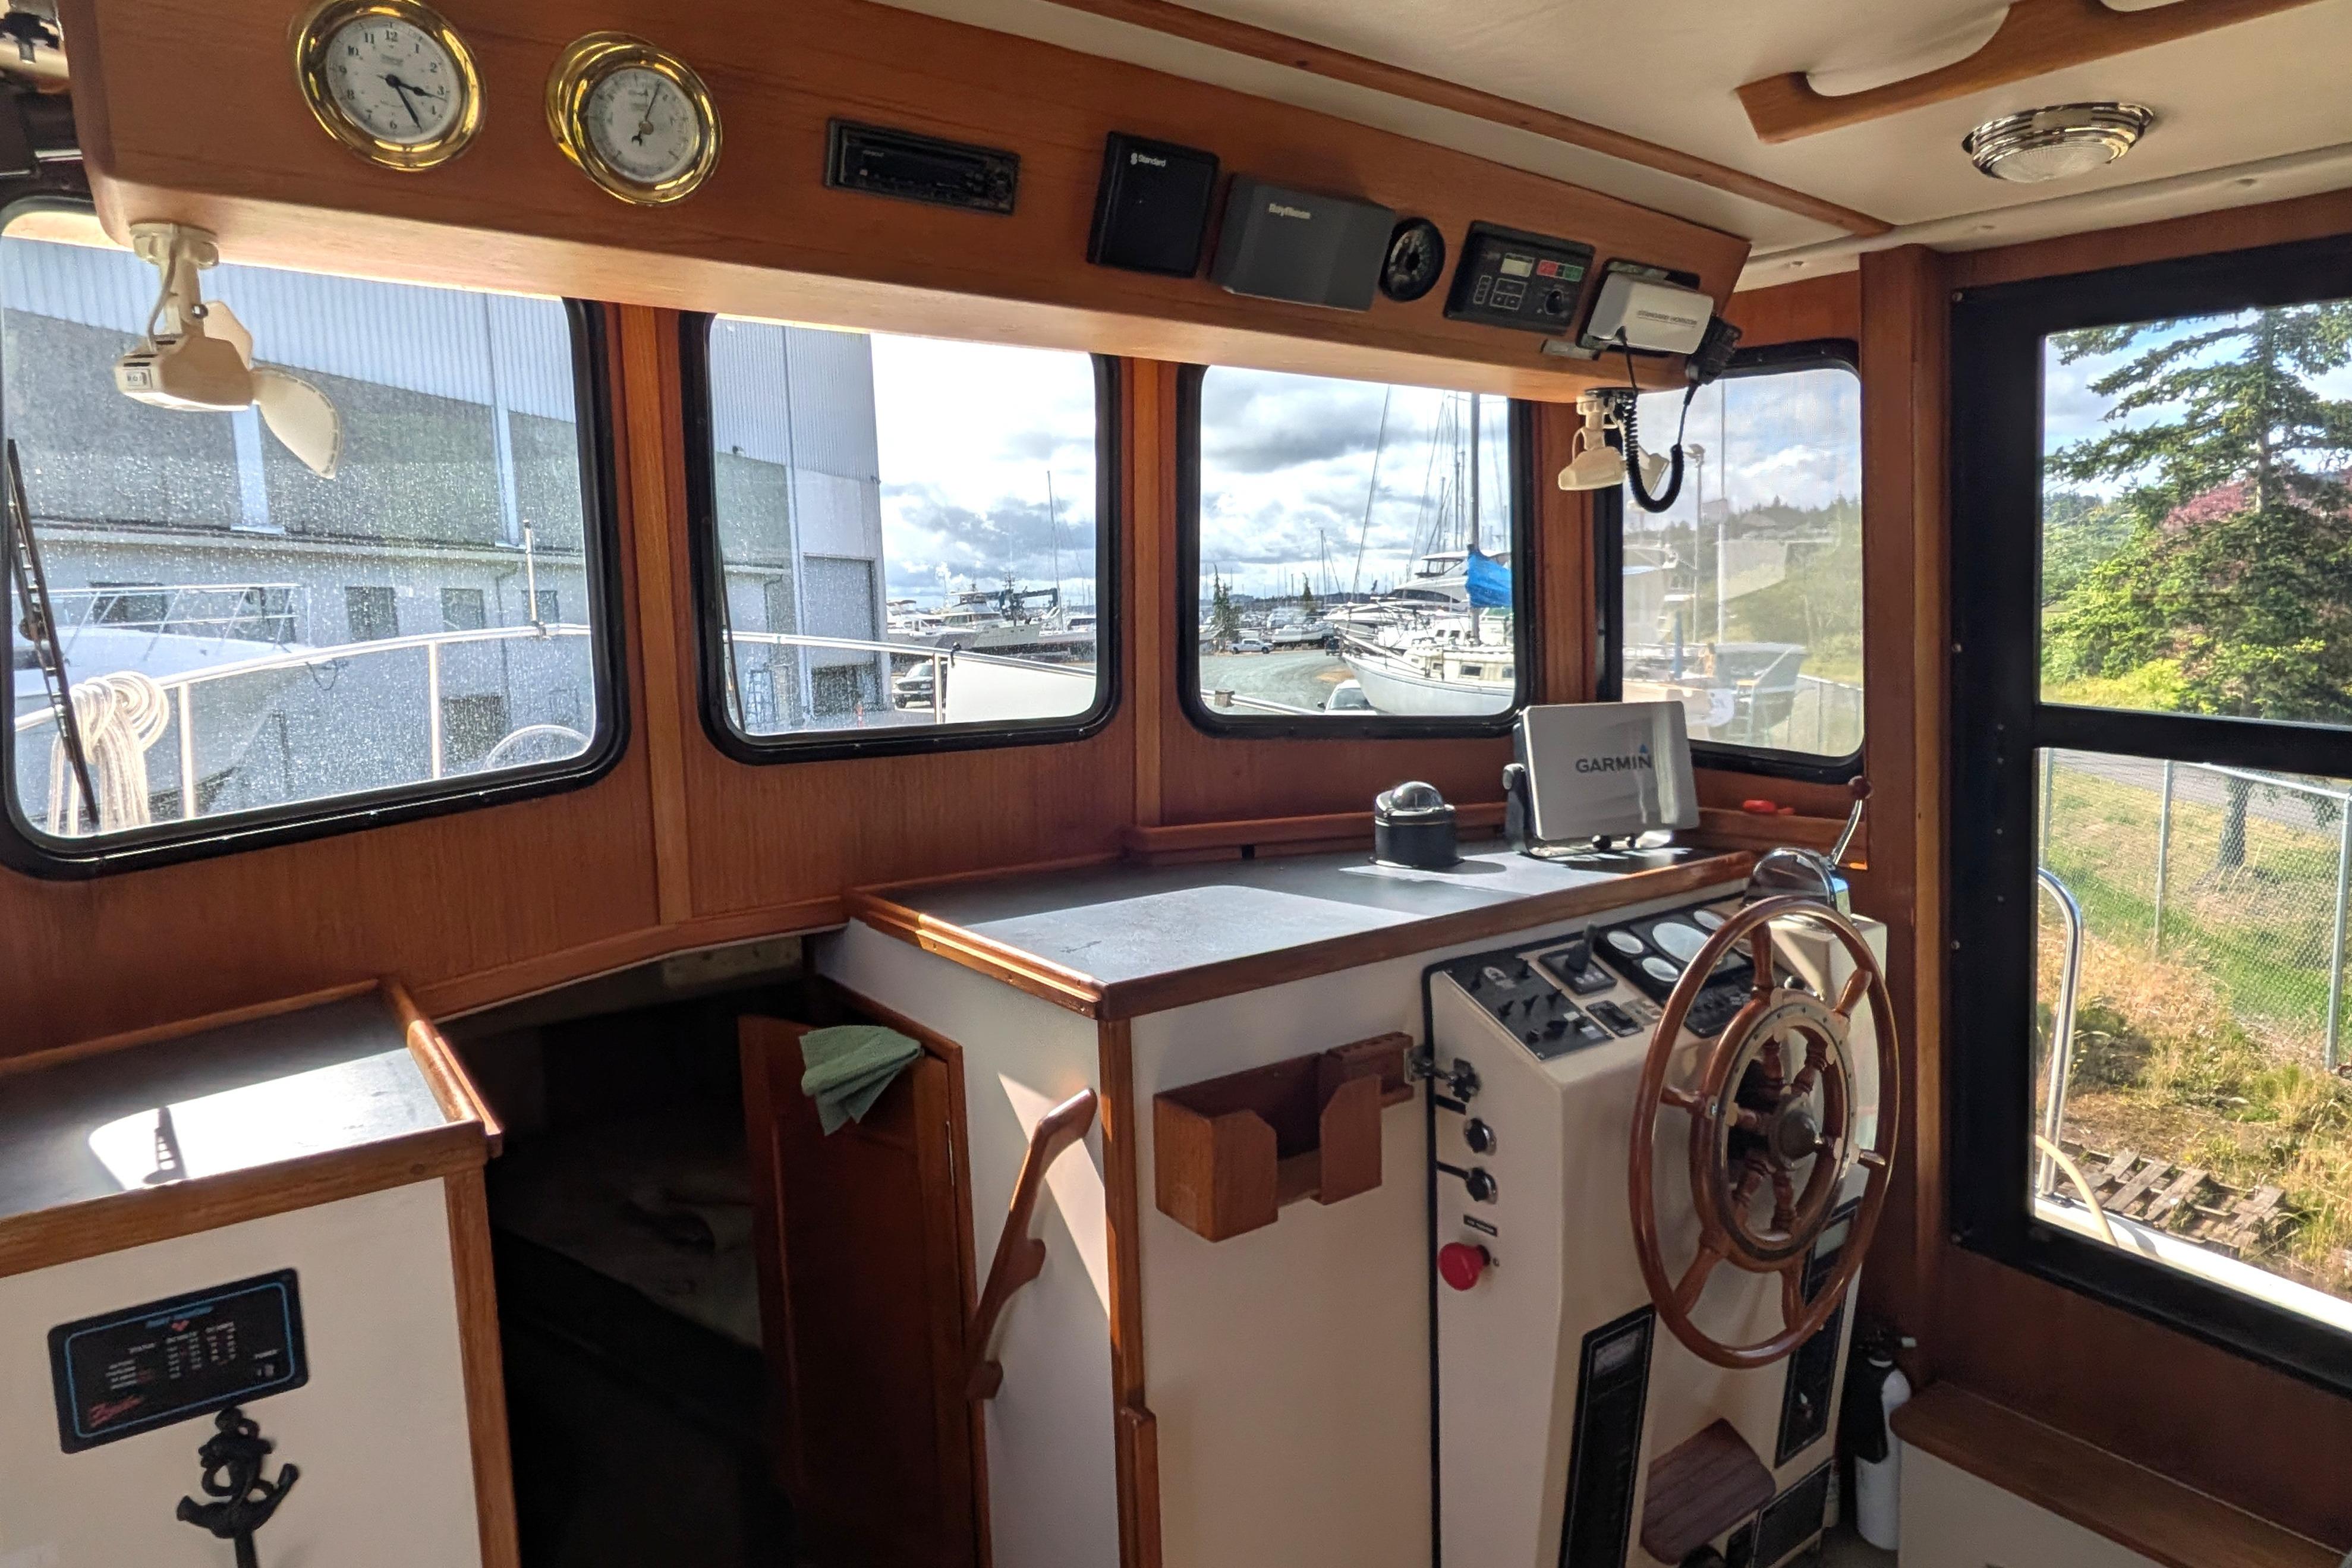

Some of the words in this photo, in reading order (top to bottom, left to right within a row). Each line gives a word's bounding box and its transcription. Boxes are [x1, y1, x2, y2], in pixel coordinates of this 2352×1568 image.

[364, 32, 375, 45] 11
[386, 30, 398, 42] 12
[430, 61, 438, 74] 2
[389, 120, 398, 130] 6
[1575, 755, 1652, 773] GARMIN
